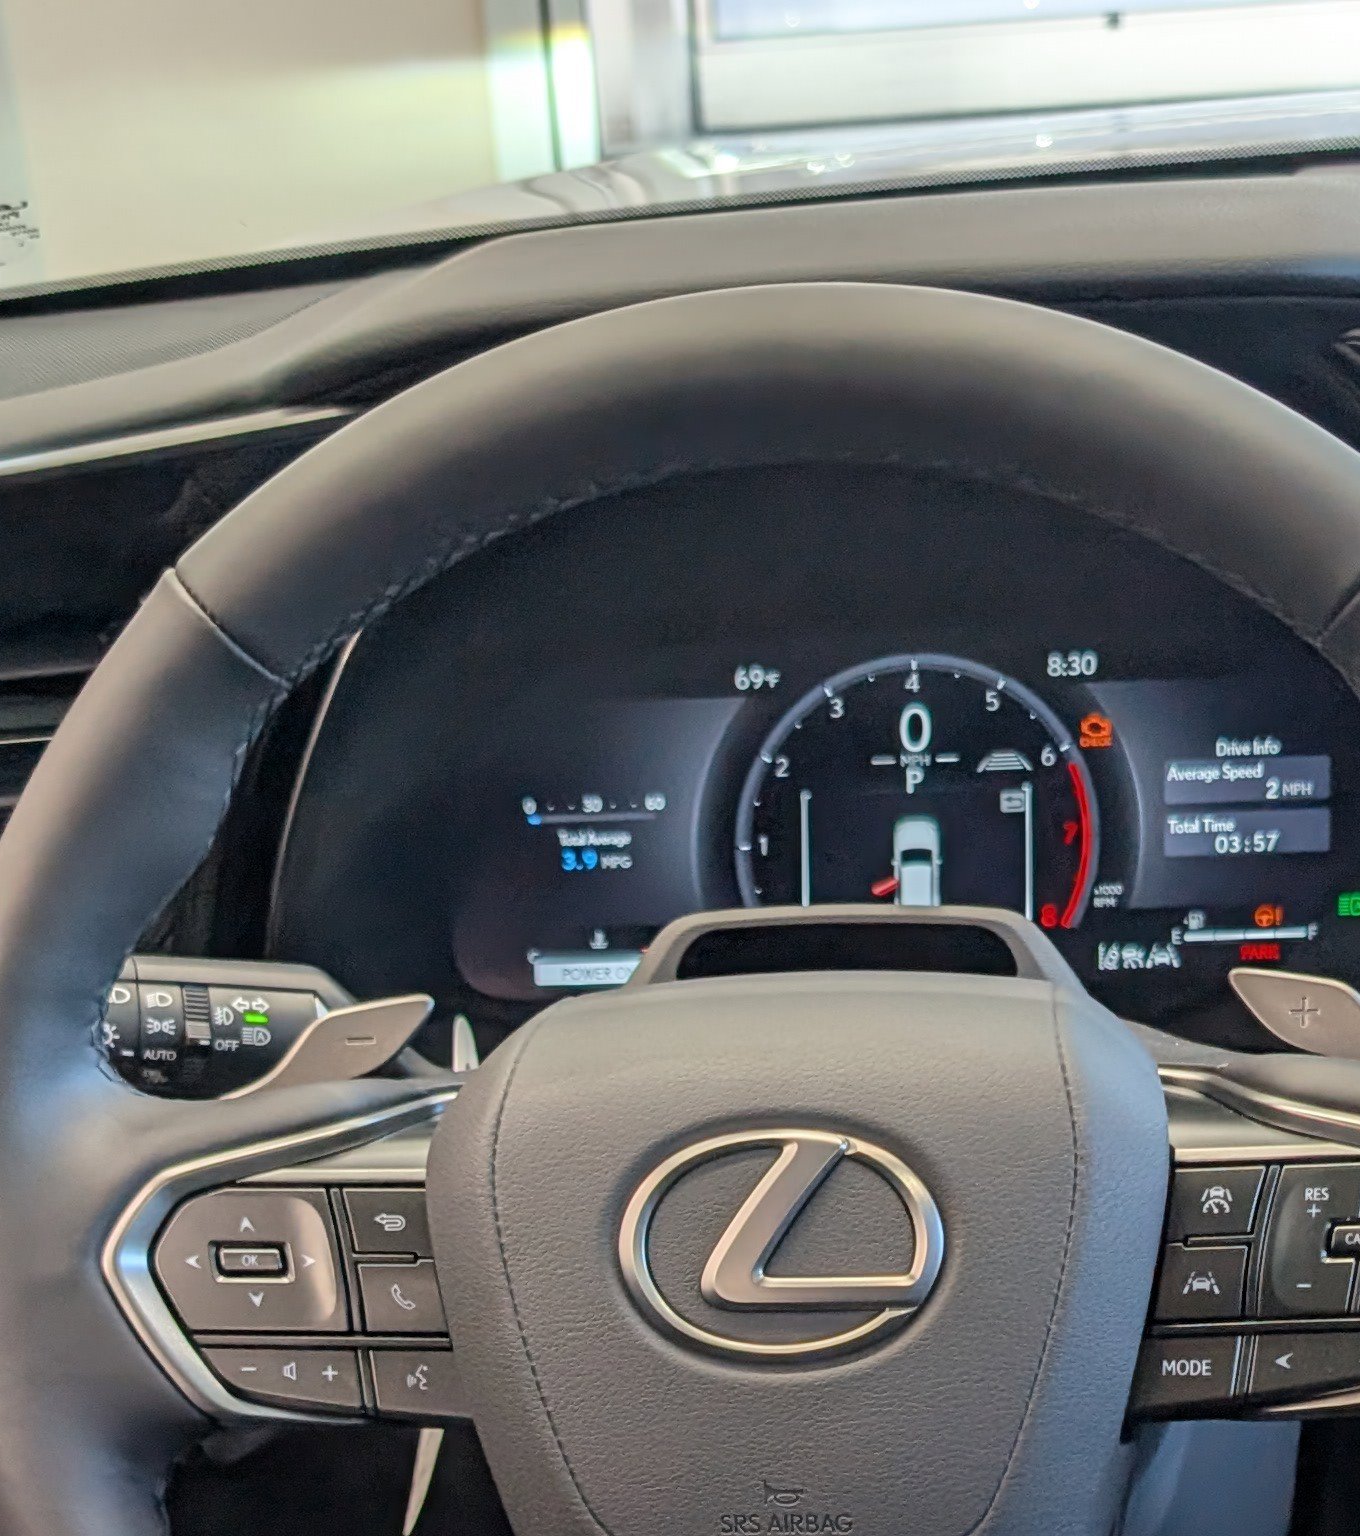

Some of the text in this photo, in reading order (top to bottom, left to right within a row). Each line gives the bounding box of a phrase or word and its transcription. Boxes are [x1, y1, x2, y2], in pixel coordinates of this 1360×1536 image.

[1047, 651, 1098, 677] 8:30
[904, 671, 921, 693] 4
[829, 697, 845, 719] 3
[985, 688, 1001, 712] 5
[899, 703, 932, 753] 0
[1041, 746, 1057, 767] 6
[1215, 738, 1282, 757] Drive Info
[774, 754, 790, 778] 2
[1167, 761, 1266, 783] Average Speed
[905, 766, 925, 795] P
[1265, 777, 1313, 800] 2 MPH
[522, 797, 537, 815] 0
[1063, 822, 1078, 846] 7
[1167, 815, 1237, 835] Total Time
[759, 833, 769, 856] 1
[561, 848, 598, 871] 3.9
[1041, 904, 1058, 927] 8
[561, 966, 612, 981] POWER
[143, 1050, 177, 1061] AUTO
[214, 1040, 239, 1051] OFF
[1304, 1186, 1330, 1202] RES
[241, 1254, 259, 1267] OK
[1161, 1359, 1212, 1377] MODE
[720, 1513, 855, 1535] SRS AIRBAG
